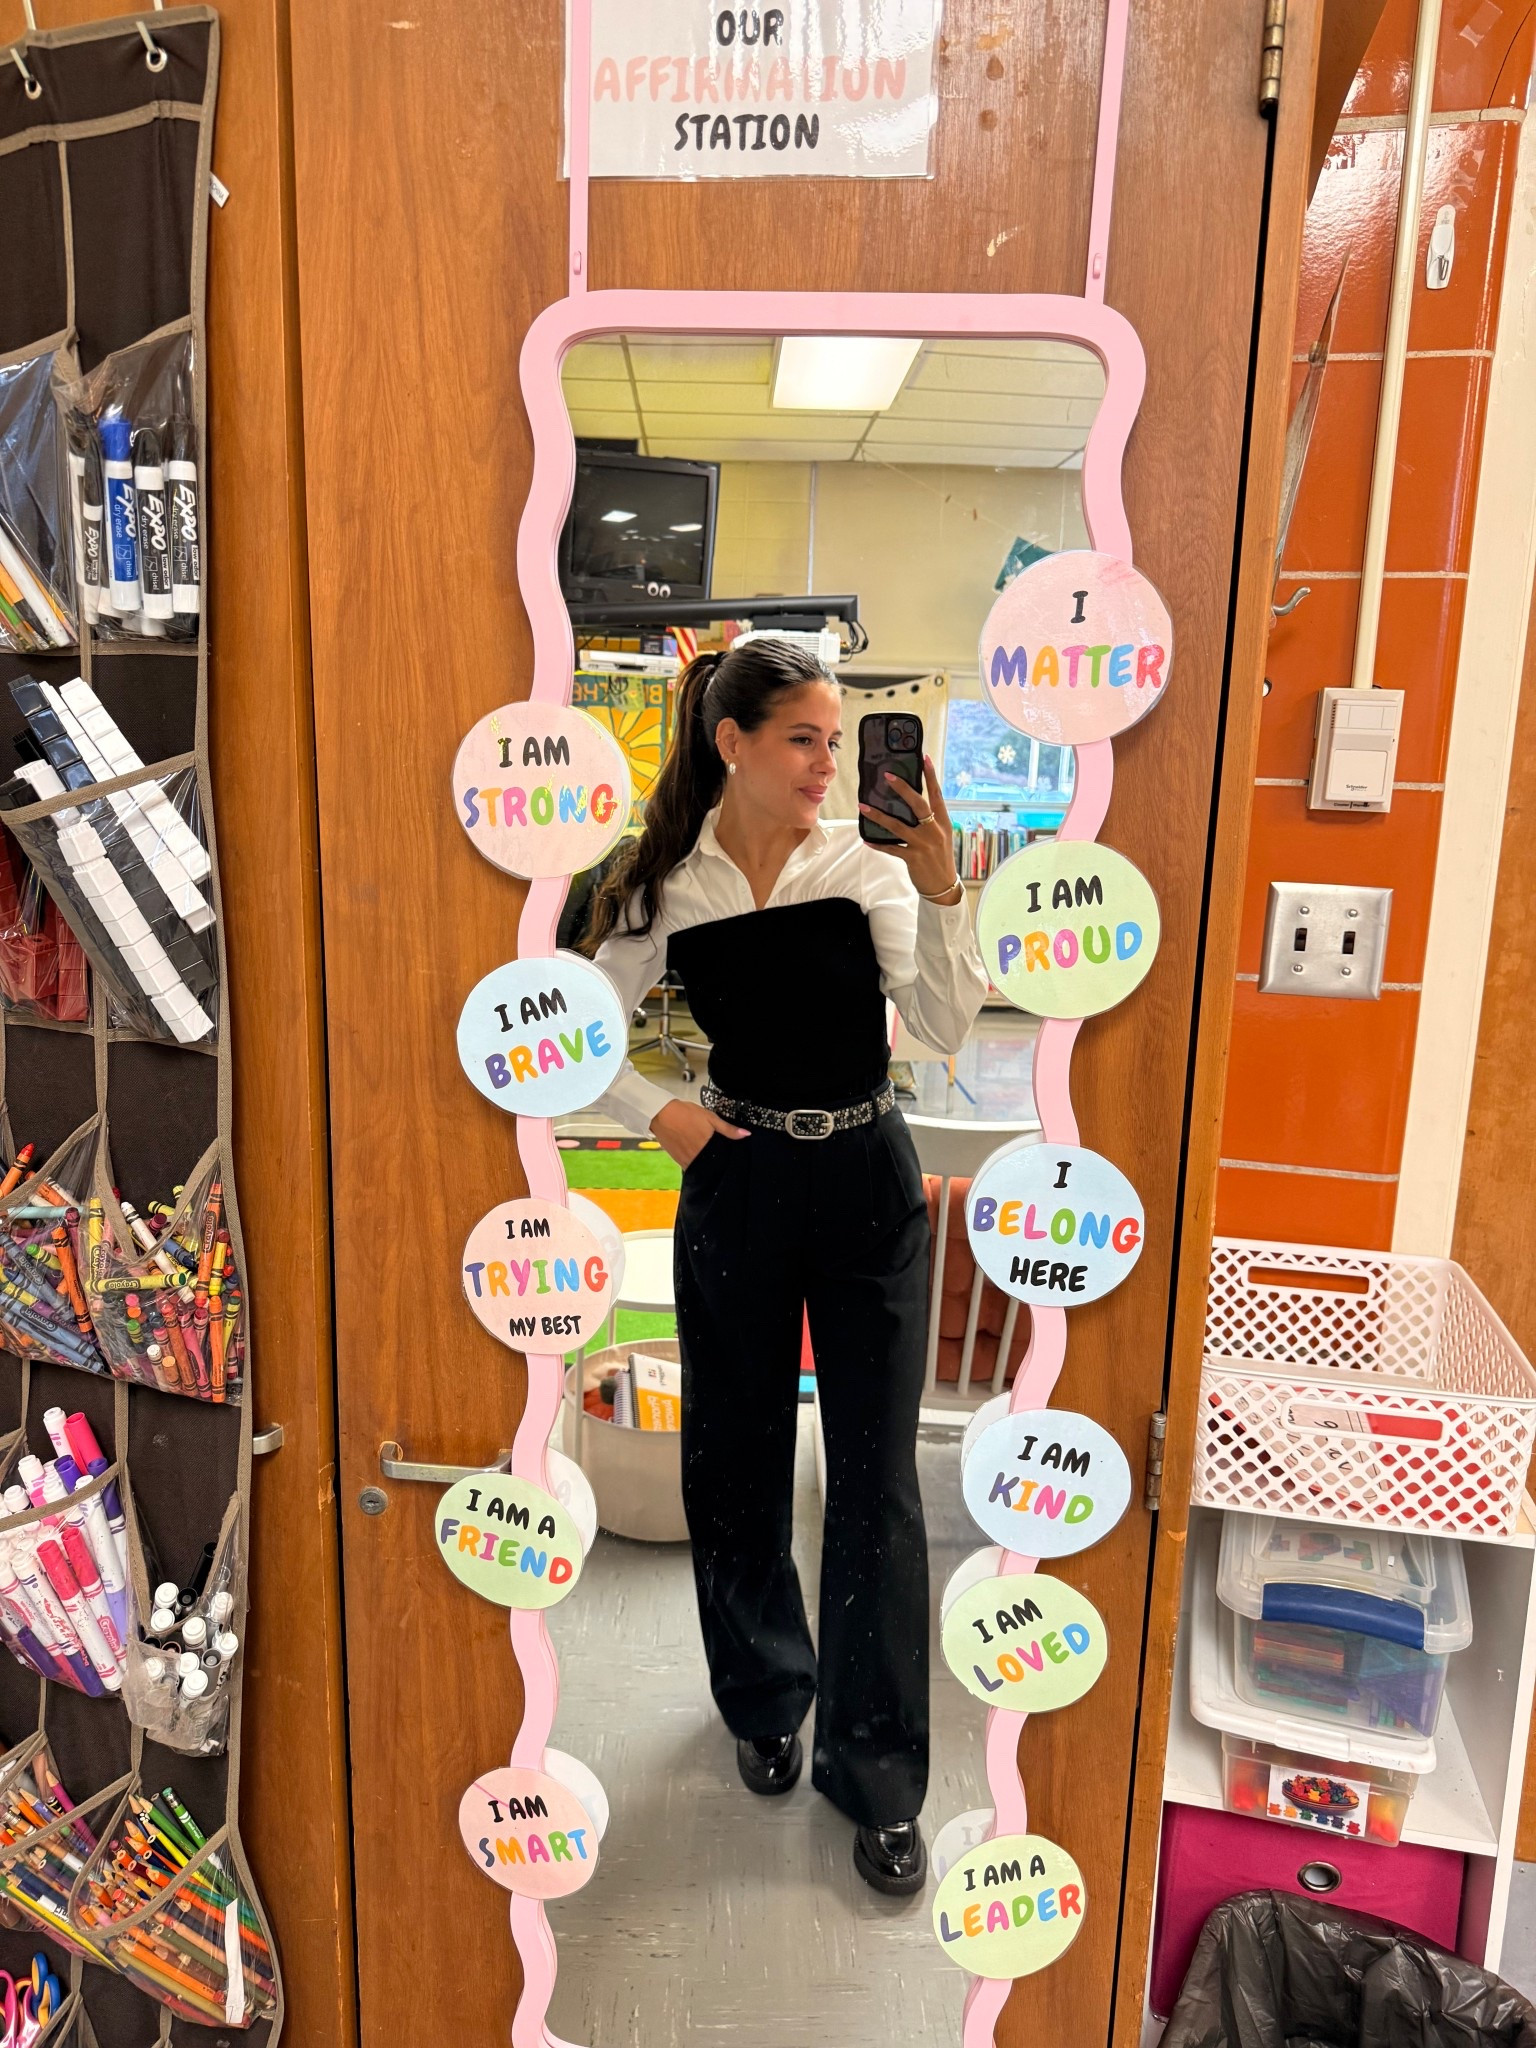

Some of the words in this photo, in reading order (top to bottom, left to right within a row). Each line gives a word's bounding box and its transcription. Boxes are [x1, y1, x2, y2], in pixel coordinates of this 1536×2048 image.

[716, 9, 784, 46] OUR
[674, 113, 820, 152] STATION
[113, 504, 121, 517] dry
[115, 483, 136, 538] EXPO
[142, 494, 167, 551] EXPO
[173, 484, 197, 541] EXPO
[84, 526, 99, 558] EXPO
[1070, 590, 1088, 623] I
[990, 644, 1165, 688] MATTER
[497, 737, 513, 768] I
[522, 735, 570, 767] AM
[463, 783, 618, 829] STRONG
[1025, 882, 1042, 913] I
[1052, 875, 1103, 909] AM
[997, 921, 1143, 975] PROUD
[494, 1003, 514, 1032] I
[520, 987, 567, 1025] AM
[485, 1020, 611, 1089] BRAVE
[1053, 1161, 1072, 1188] I
[505, 1219, 516, 1239] I
[521, 1218, 551, 1238] AM
[973, 1196, 1141, 1254] BELONG
[109, 1279, 139, 1290] Crayola
[464, 1256, 609, 1298] TRYING
[1009, 1255, 1088, 1293] HERE
[25, 1307, 56, 1330] Crayola
[509, 1316, 536, 1337] MY
[541, 1315, 582, 1336] BEST
[1017, 1435, 1038, 1460] I
[1040, 1442, 1091, 1477] AM
[466, 1489, 482, 1511] I
[487, 1497, 530, 1530] AM
[537, 1515, 555, 1539] A
[988, 1471, 1094, 1524] KIND
[440, 1518, 573, 1584] FRIEND
[972, 1619, 994, 1643] I
[996, 1598, 1043, 1635] AM
[973, 1622, 1090, 1692] LOVED
[488, 1800, 504, 1823] I
[509, 1795, 549, 1821] AM
[478, 1828, 588, 1868] SMART
[963, 1868, 977, 1892] I
[984, 1859, 1022, 1887] AM
[1030, 1854, 1046, 1878] A
[939, 1883, 1082, 1943] LEADER
